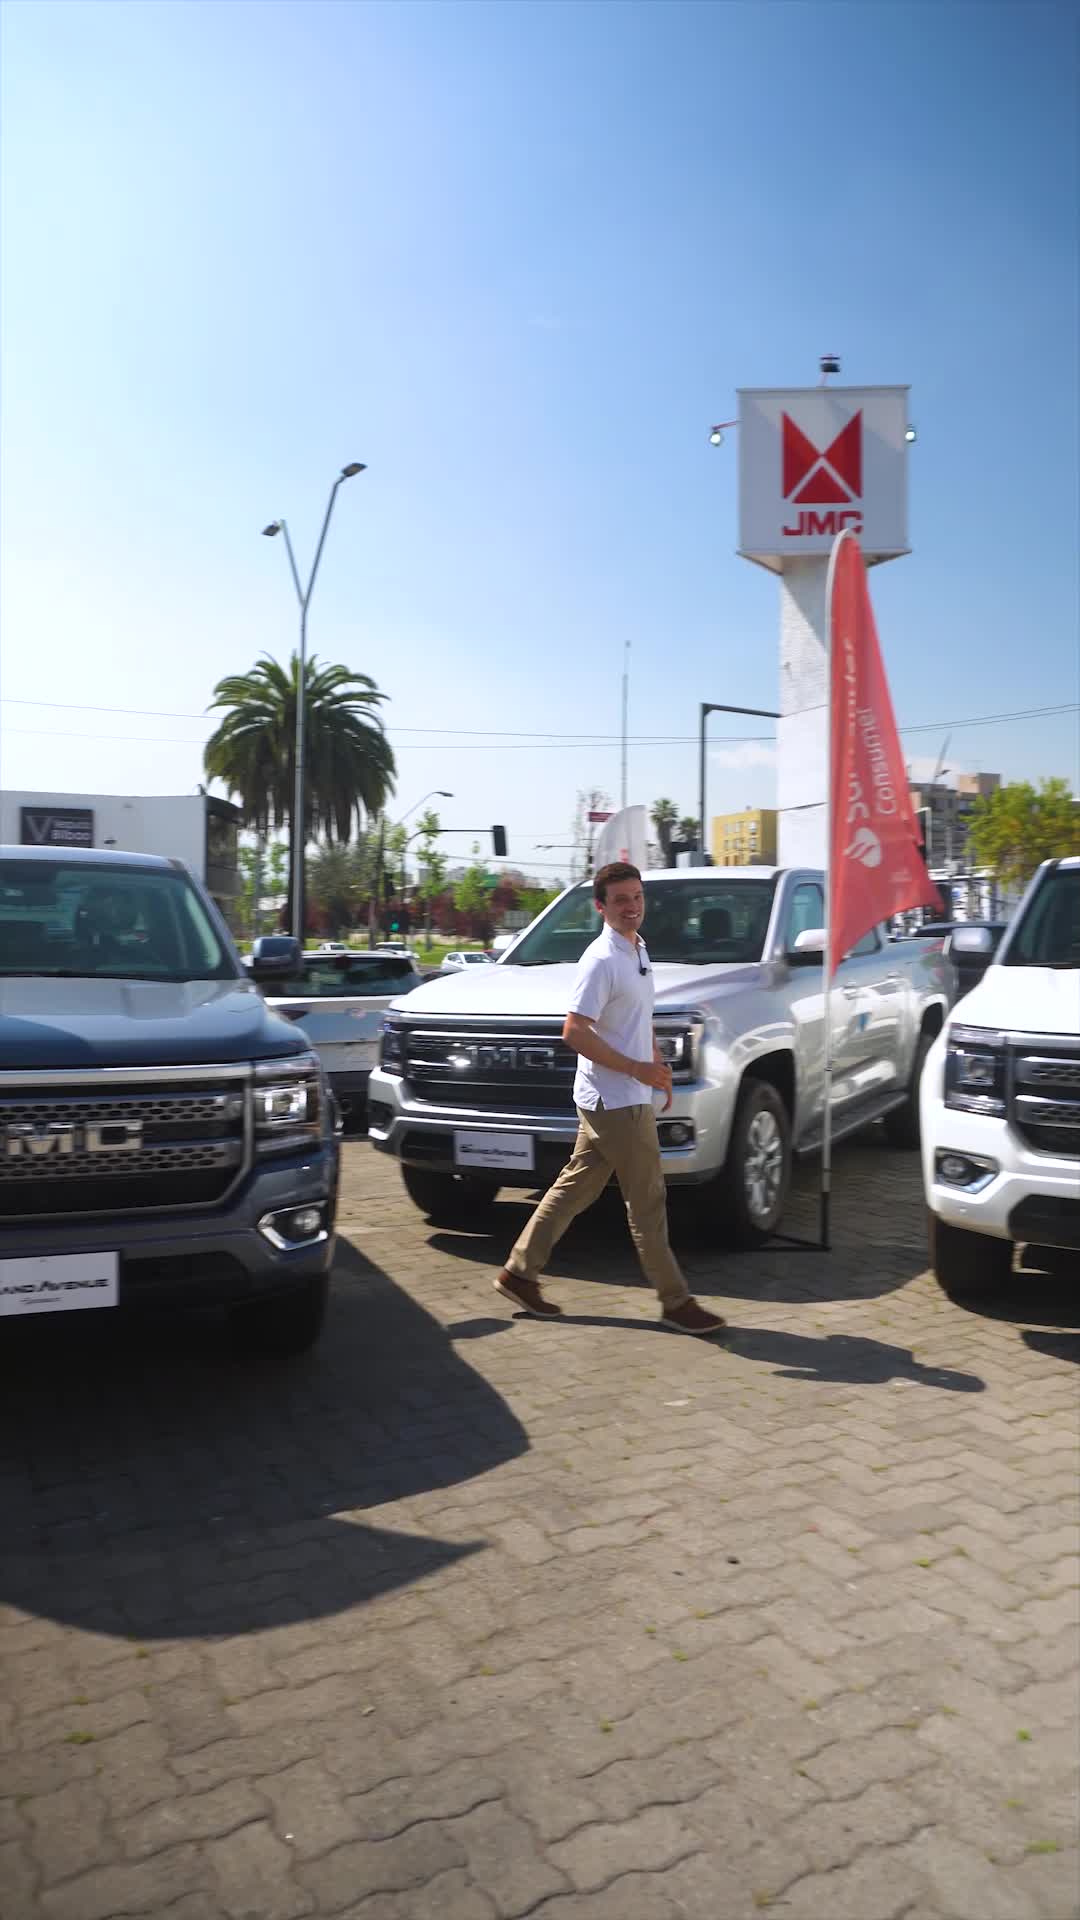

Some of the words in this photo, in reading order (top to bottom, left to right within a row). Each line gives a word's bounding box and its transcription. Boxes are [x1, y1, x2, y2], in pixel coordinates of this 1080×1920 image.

[782, 510, 863, 536] JMC
[856, 705, 897, 815] Consumer
[6, 1119, 143, 1156] MC
